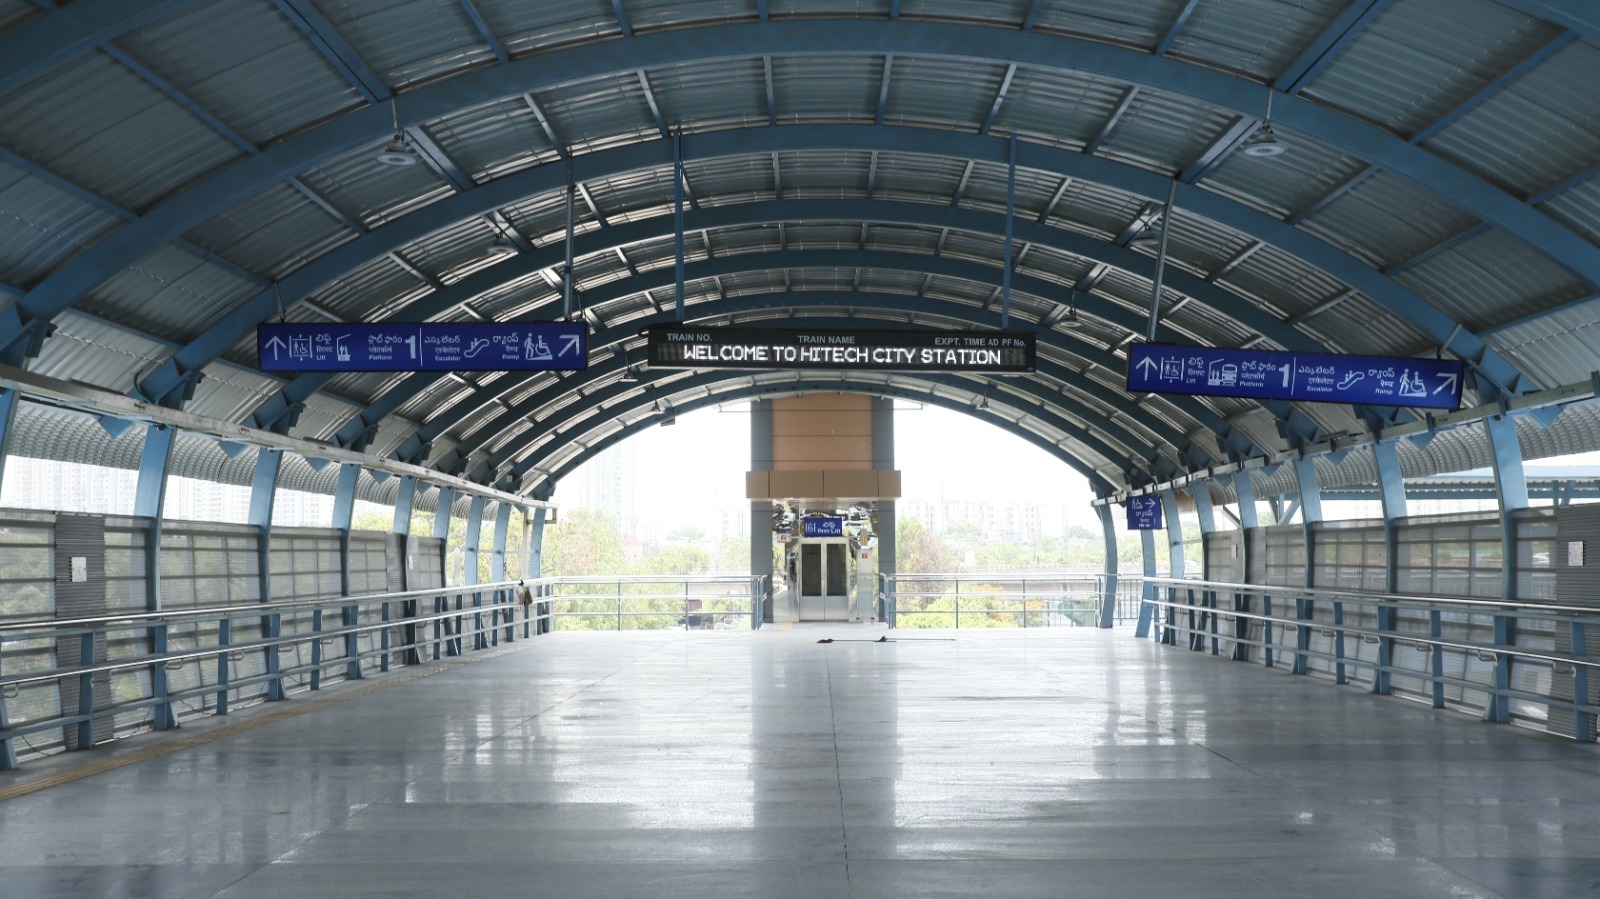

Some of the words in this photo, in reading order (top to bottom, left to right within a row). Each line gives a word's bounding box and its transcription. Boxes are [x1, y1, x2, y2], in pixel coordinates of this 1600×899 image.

[667, 333, 694, 341] TRAIN
[697, 334, 712, 342] NO.
[828, 336, 855, 344] NAME
[935, 337, 960, 345] EXPT.
[964, 338, 985, 346] TIME
[405, 335, 416, 359] 1
[684, 345, 768, 360] WELCOME
[773, 346, 796, 361] TO
[800, 347, 868, 362] HITECH
[872, 348, 916, 363] CITY
[921, 349, 1000, 365] STATION
[1279, 364, 1290, 387] 1
